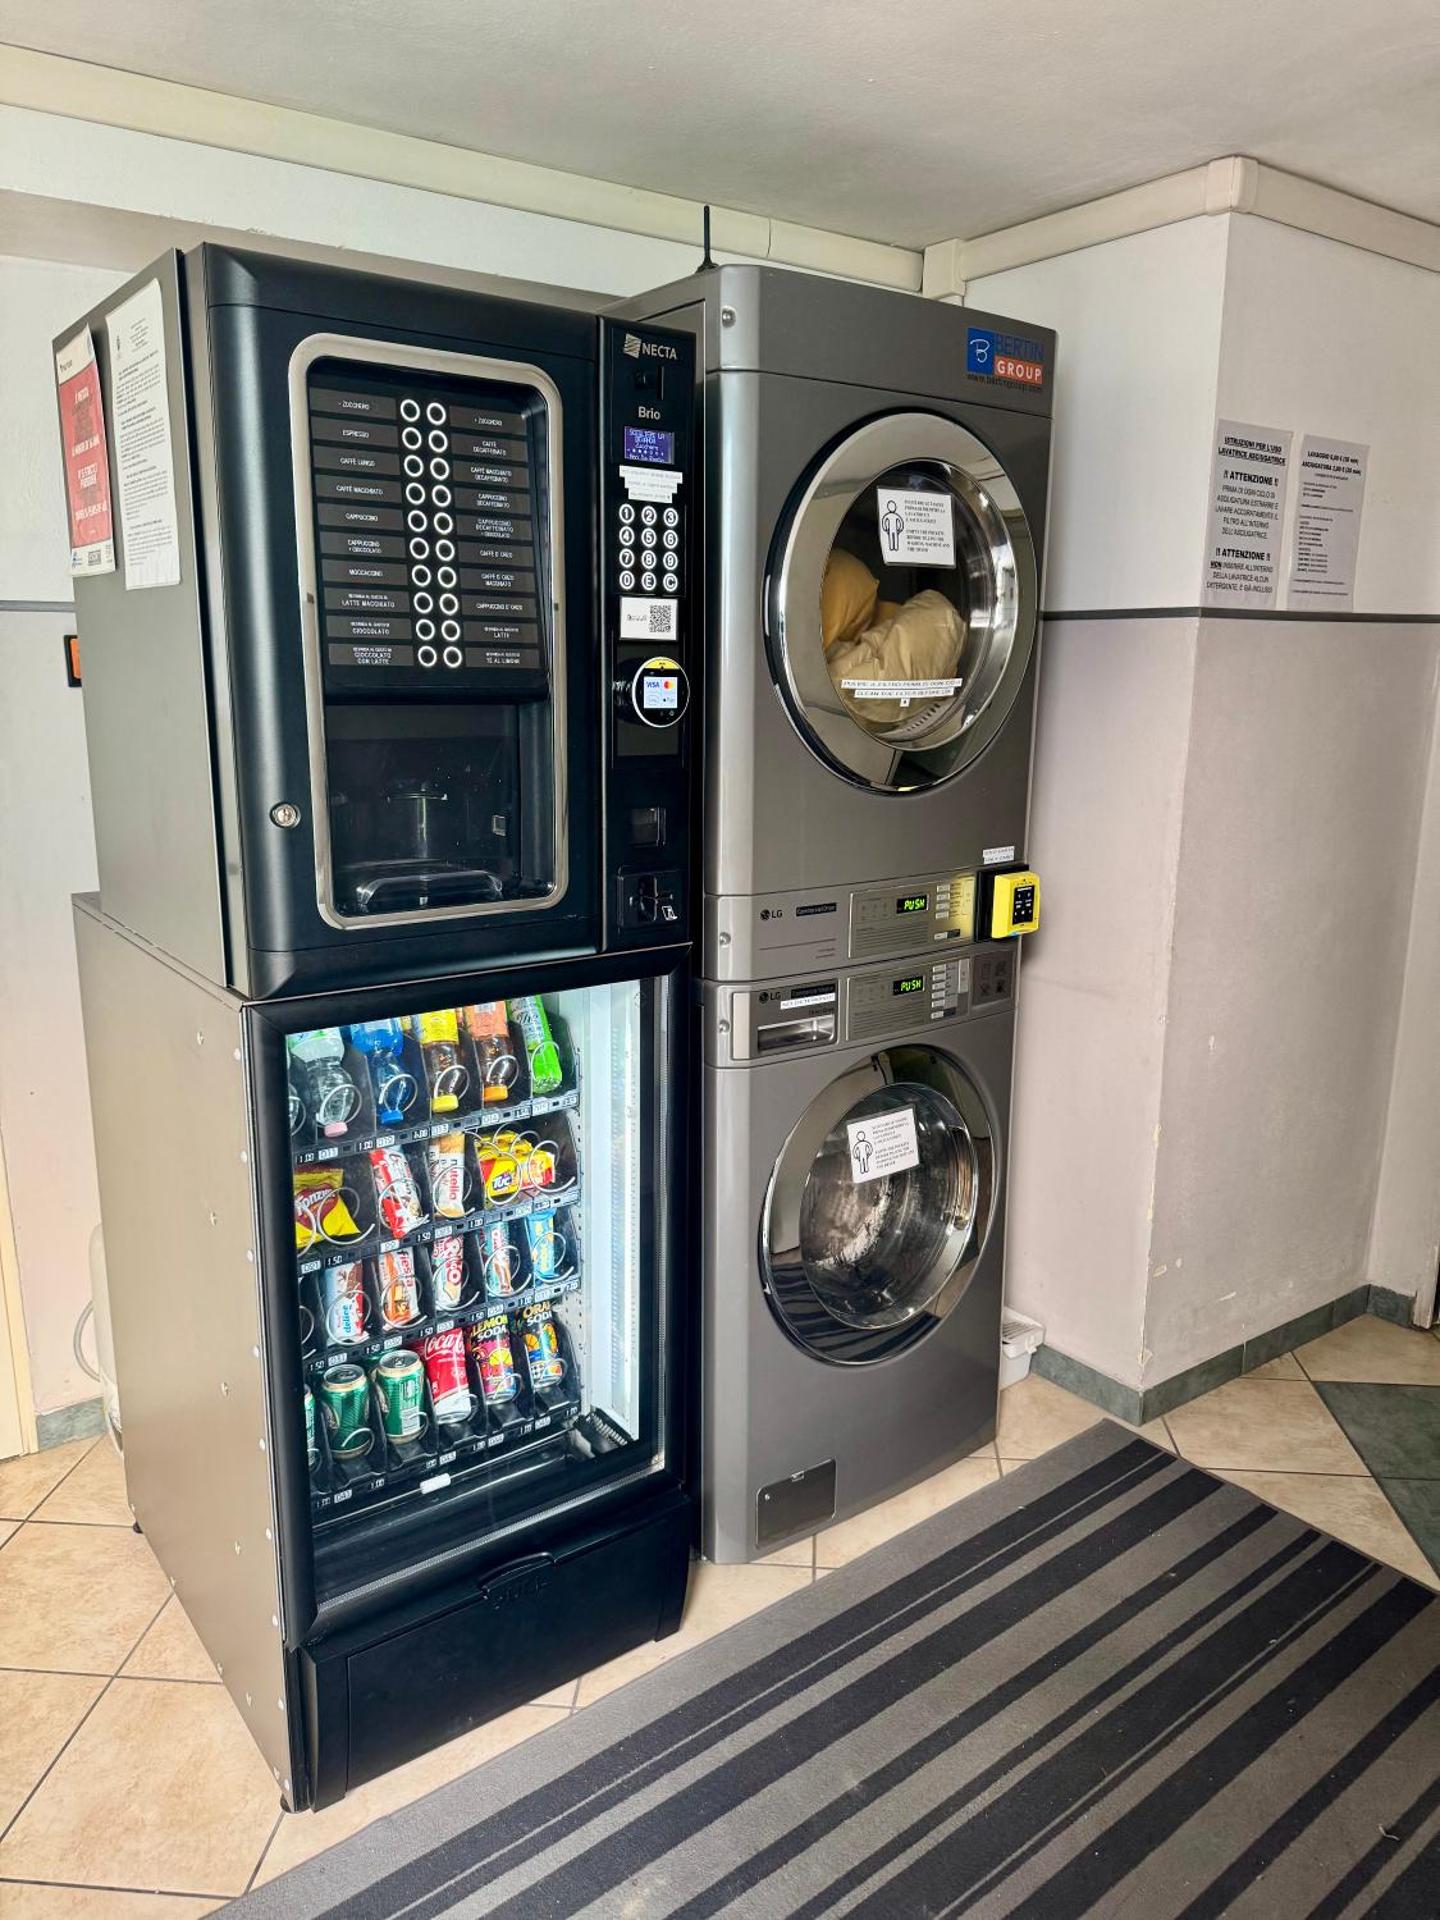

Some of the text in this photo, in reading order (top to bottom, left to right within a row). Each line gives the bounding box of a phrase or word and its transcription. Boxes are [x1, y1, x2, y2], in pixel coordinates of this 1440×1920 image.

[641, 342, 677, 360] NECTA
[996, 360, 1042, 381] GROUP
[638, 406, 661, 420] Brio
[1229, 471, 1273, 486] ATTENZIONE
[623, 508, 675, 523] 1 2 3
[622, 529, 674, 544] 4 5 6
[623, 552, 674, 567] 7 8 9
[1222, 548, 1265, 560] ATTENZIONE
[645, 576, 652, 588] E
[666, 576, 675, 588] C
[646, 681, 660, 689] VISA
[903, 898, 925, 911] PUSH
[771, 909, 783, 919] LG
[900, 979, 922, 992] PUSH
[770, 991, 781, 1001] LG
[473, 1314, 508, 1336] LEMON
[477, 1326, 507, 1340] SODA
